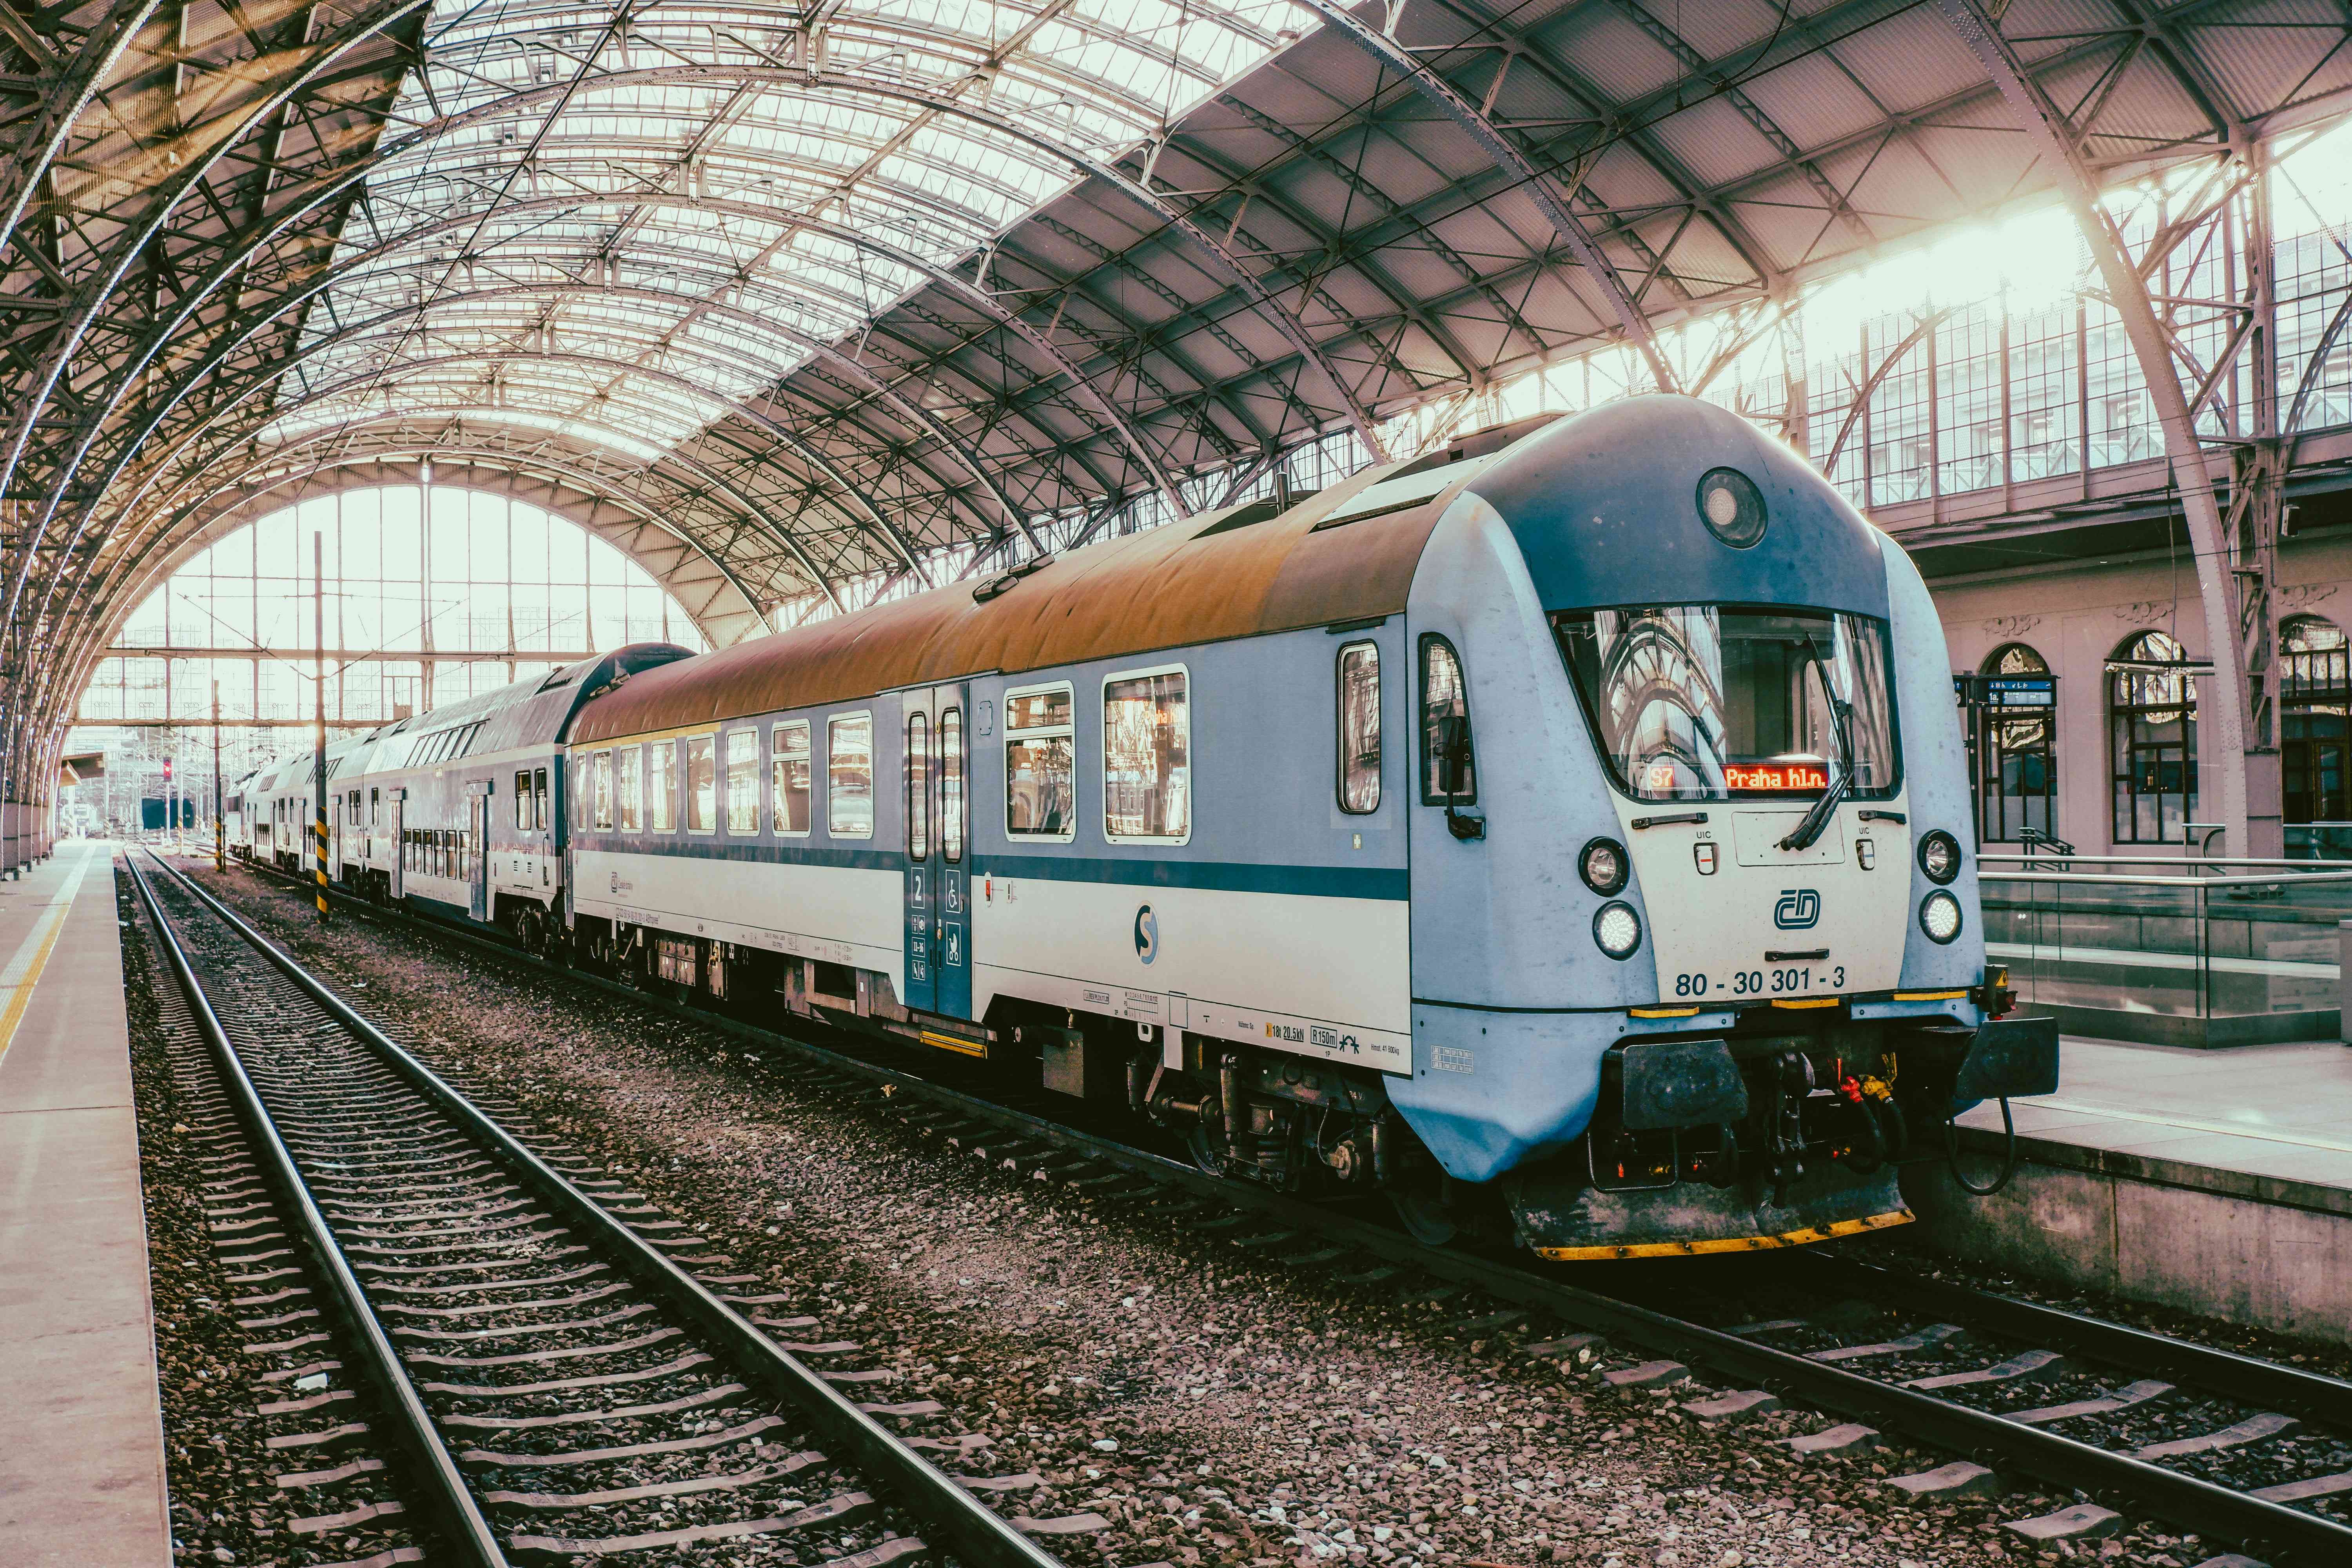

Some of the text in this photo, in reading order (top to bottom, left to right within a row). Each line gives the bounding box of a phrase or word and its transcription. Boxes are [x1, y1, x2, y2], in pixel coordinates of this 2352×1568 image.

[1989, 692, 1998, 701] 1a.
[1726, 769, 1826, 787] Praha hl.n.
[915, 875, 922, 901] 2
[913, 941, 924, 953] 11-36
[1675, 973, 1707, 996] 80
[1733, 971, 1763, 994] 30
[1771, 967, 1809, 992] 301
[1833, 966, 1844, 988] 3
[1272, 1025, 1304, 1040] 18t 20.5kN
[1313, 1029, 1335, 1045] R 150m
